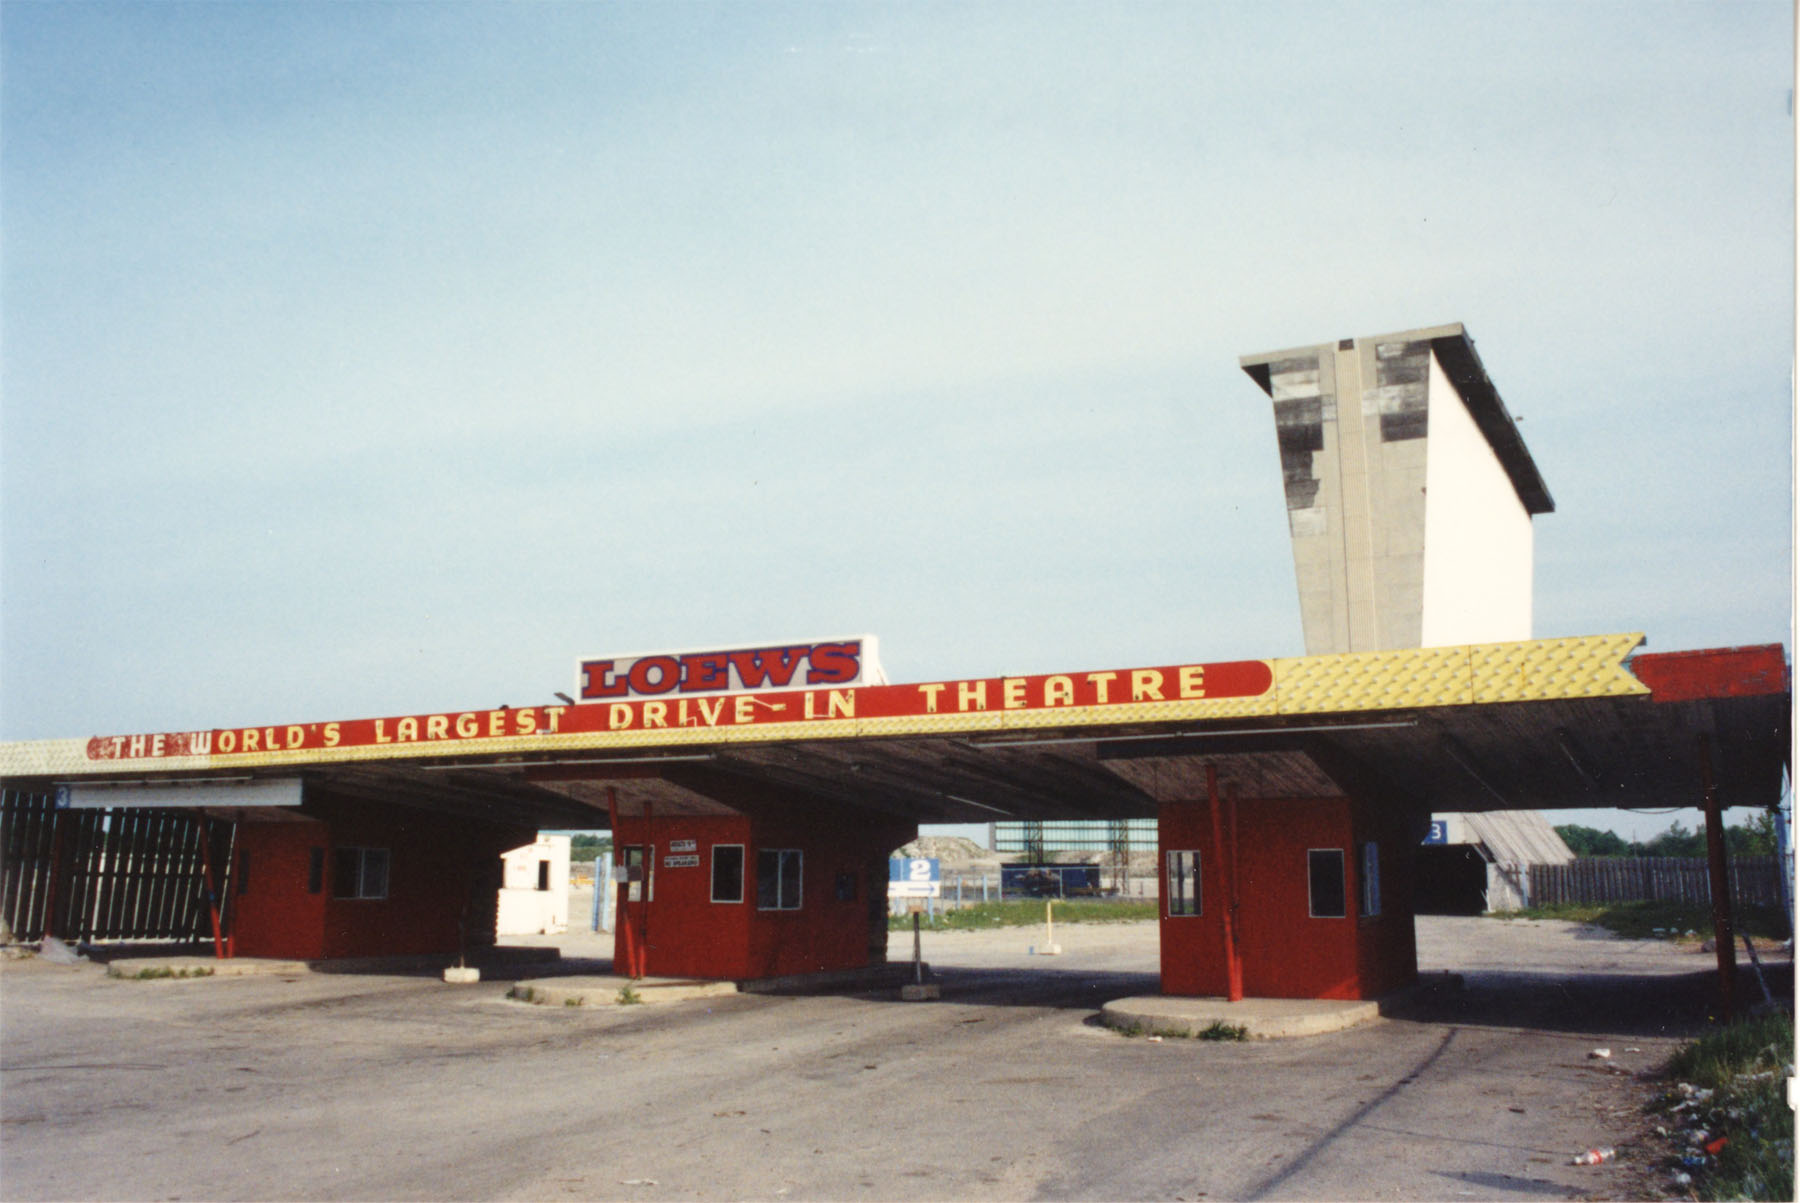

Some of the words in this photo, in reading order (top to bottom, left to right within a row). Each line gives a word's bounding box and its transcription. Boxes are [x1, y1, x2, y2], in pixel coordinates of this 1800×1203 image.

[582, 642, 860, 698] LOEWS
[111, 735, 166, 760] THE
[190, 723, 340, 755] WORLD'S
[374, 706, 565, 743] LARGEST
[918, 666, 1205, 713] THEATRE
[910, 860, 930, 881] 2
